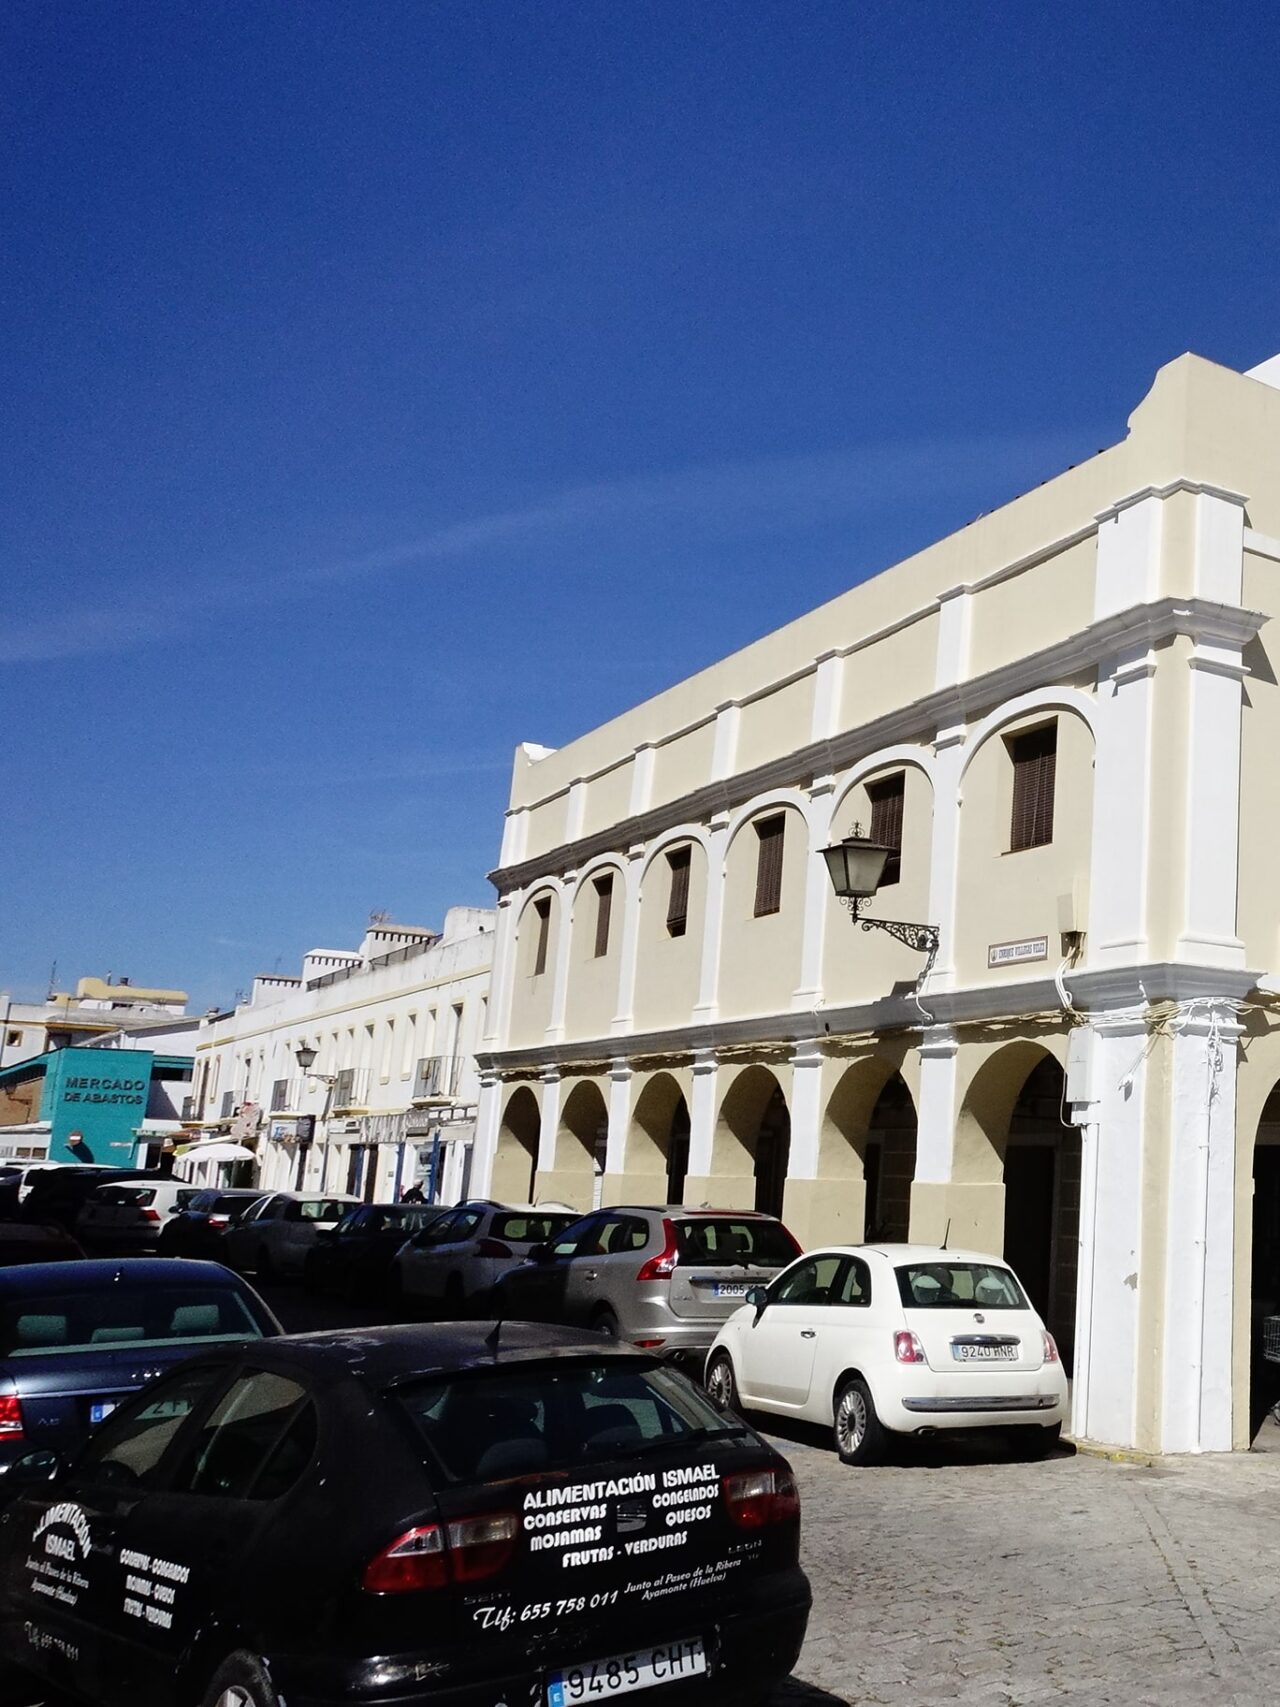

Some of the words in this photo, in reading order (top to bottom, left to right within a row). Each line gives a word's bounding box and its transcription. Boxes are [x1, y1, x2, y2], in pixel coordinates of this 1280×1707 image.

[64, 1092, 81, 1102] DE
[83, 1093, 143, 1105] ABASTOS
[65, 1077, 145, 1091] MERCADO
[720, 1285, 745, 1295] 2005
[961, 1346, 990, 1358] 9240
[523, 1472, 656, 1511] ALIMENTACIÓN
[662, 1464, 720, 1488] ISMAEL
[523, 1503, 607, 1530] CONSERVAS
[652, 1484, 719, 1509] CONGELADOS
[32, 1503, 92, 1559] ALIMENTACIÓN
[530, 1526, 602, 1551] MOJAMAS
[665, 1505, 712, 1527] QUESOS
[45, 1533, 76, 1561] ISMAEL
[562, 1546, 614, 1568] FRUTAS
[625, 1531, 688, 1557] VERDURAS
[624, 1579, 652, 1594] Junto
[654, 1576, 664, 1588] al
[665, 1572, 691, 1586] Paseo
[693, 1567, 704, 1579] de
[705, 1565, 714, 1577] la
[715, 1559, 742, 1573] Ribera
[642, 1584, 687, 1601] Ayamonte
[690, 1572, 727, 1588] (Huelva)
[520, 1602, 551, 1622] 655
[556, 1597, 585, 1616] 758
[590, 1590, 619, 1609] 011
[567, 1655, 640, 1699] 9485
[651, 1642, 701, 1679] CHT
